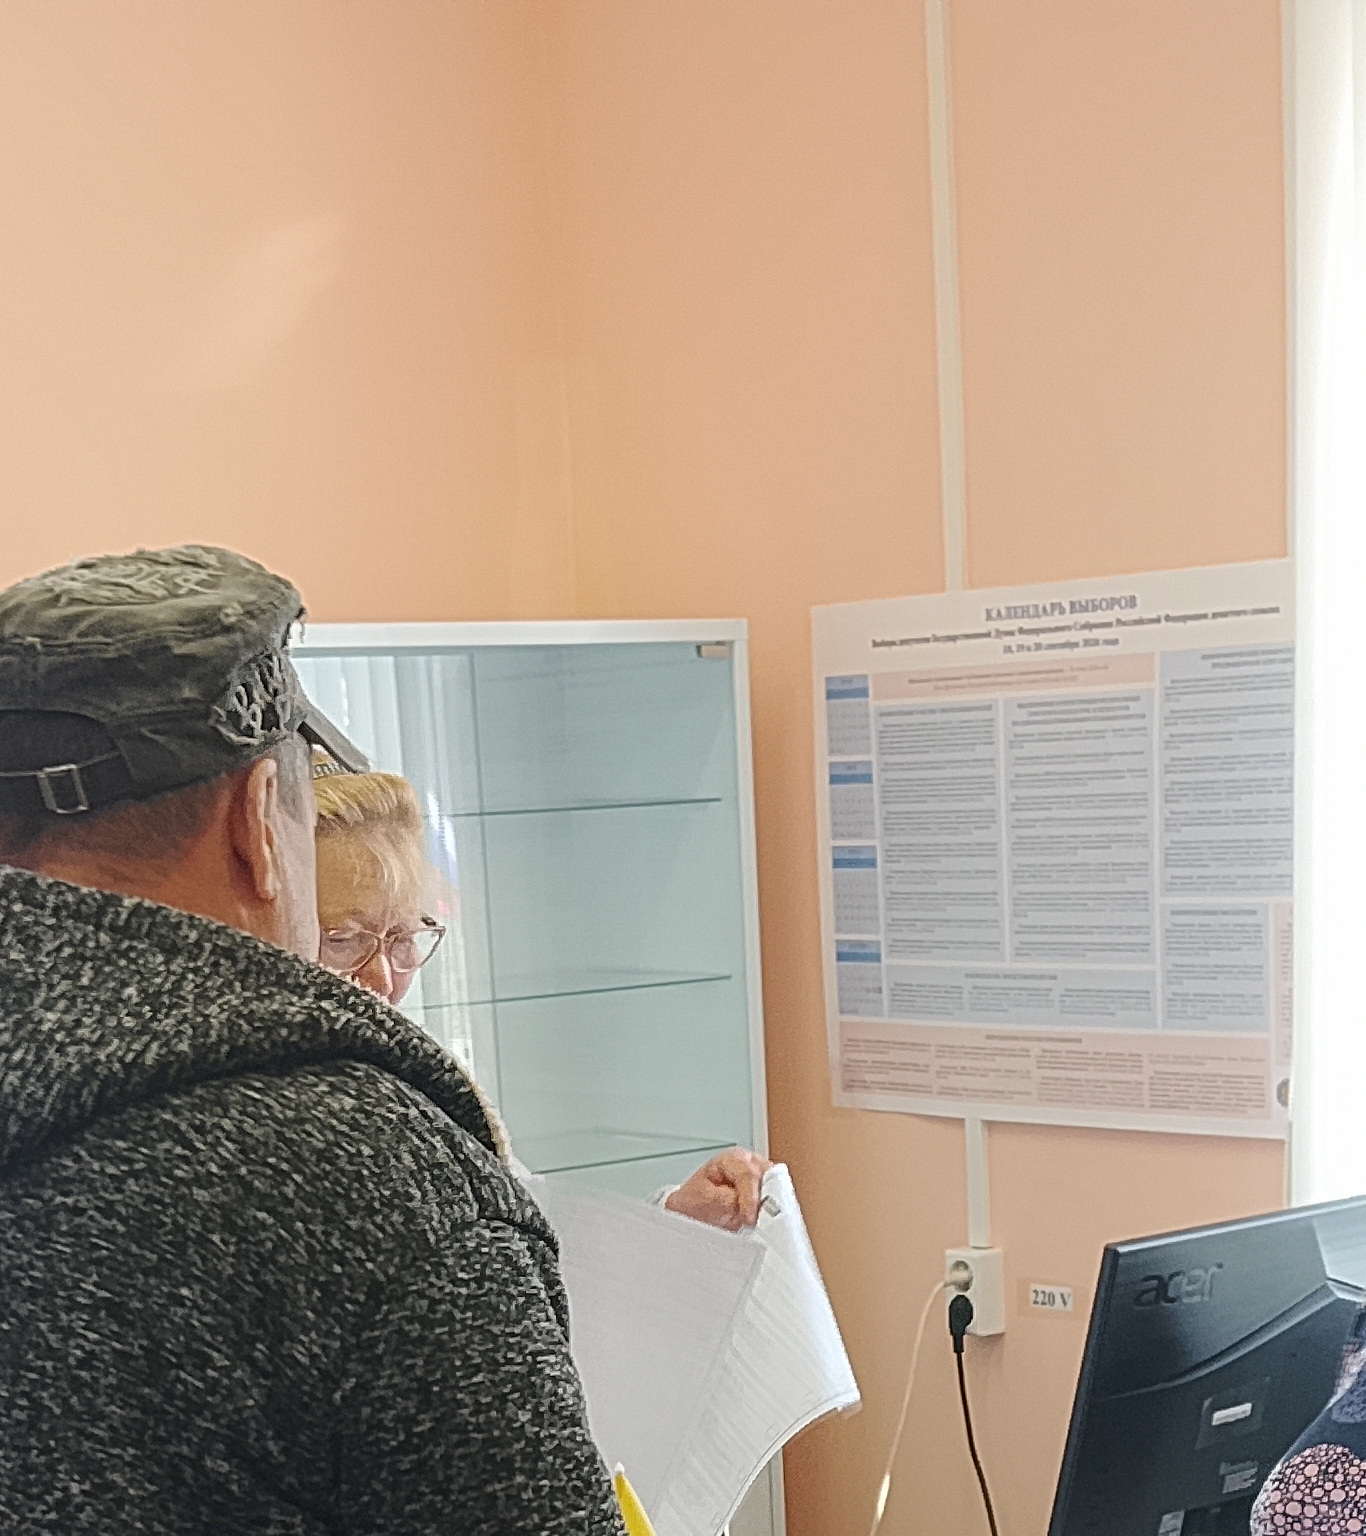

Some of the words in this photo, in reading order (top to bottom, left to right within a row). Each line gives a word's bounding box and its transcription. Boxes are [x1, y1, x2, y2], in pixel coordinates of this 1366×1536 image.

[985, 602, 1066, 621] КАЛЕНДАРЬ
[1069, 595, 1137, 614] ВЫБОРОВ
[1135, 1262, 1224, 1307] acer
[1032, 1289, 1056, 1307] 220
[1059, 1291, 1072, 1307] V
